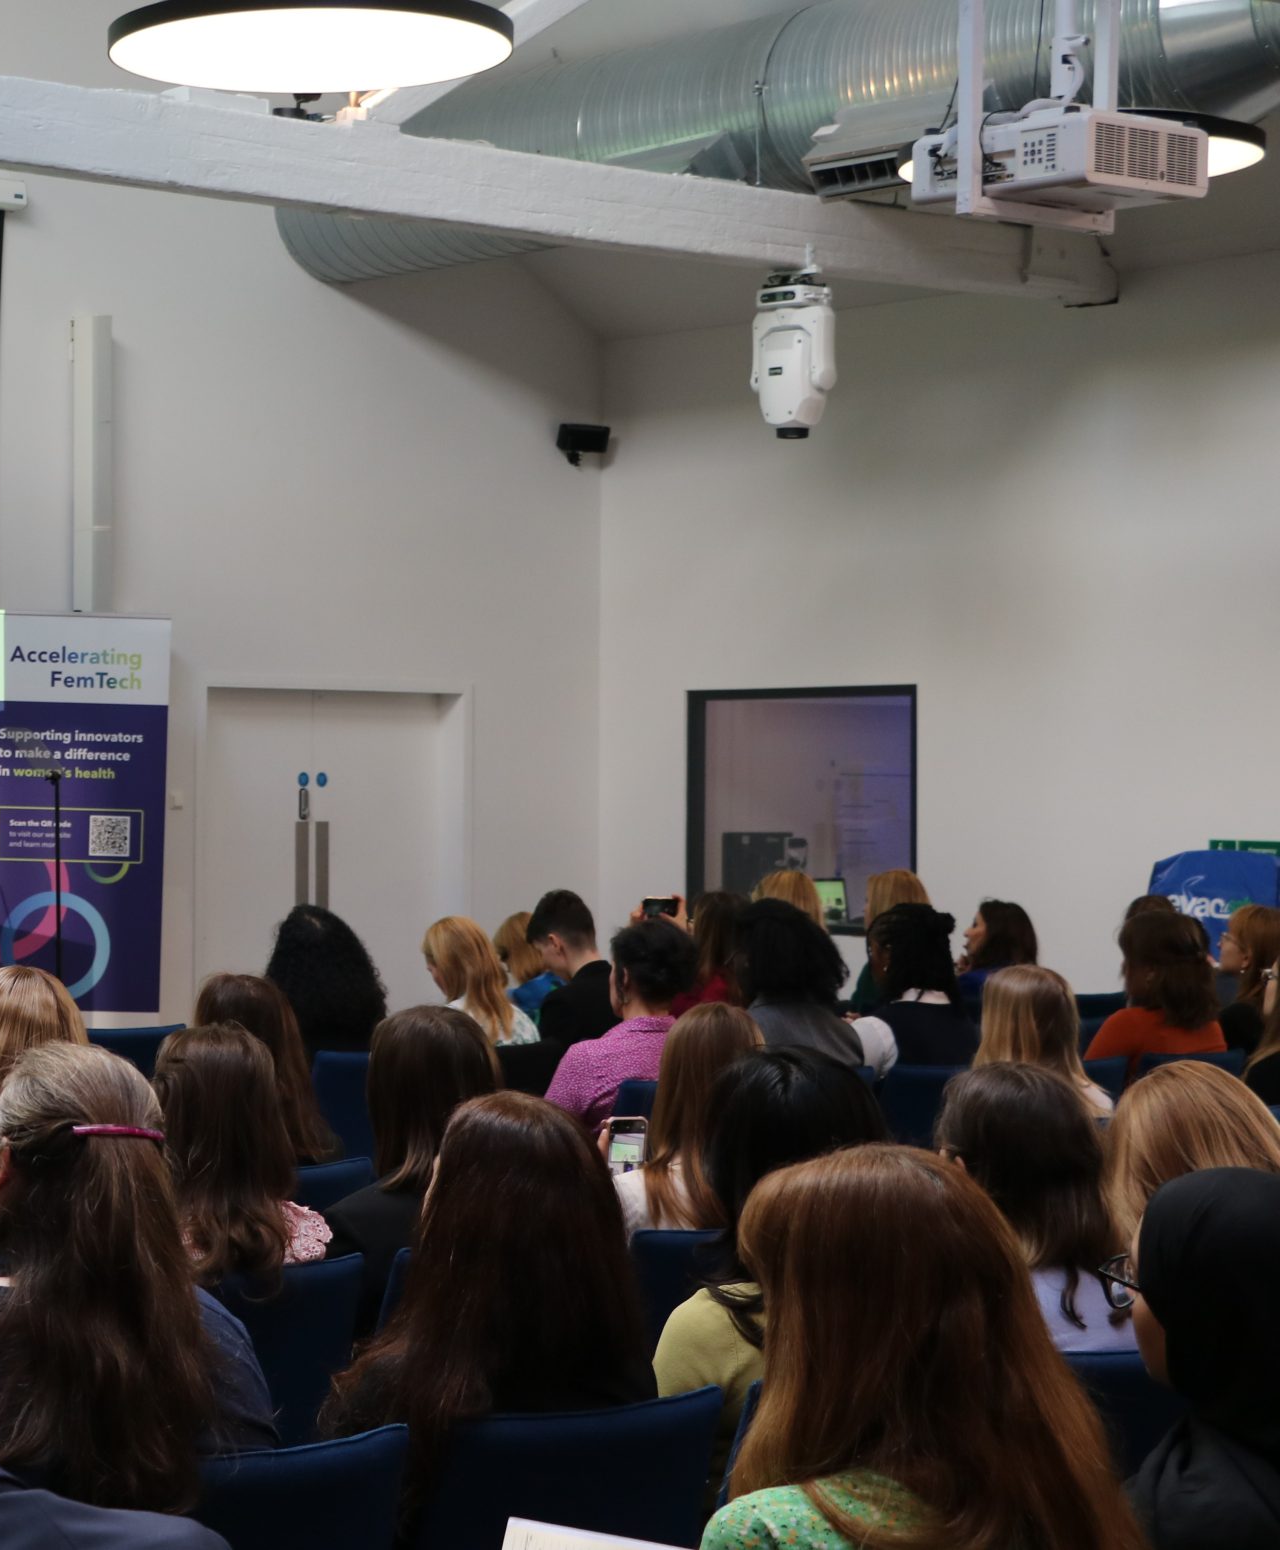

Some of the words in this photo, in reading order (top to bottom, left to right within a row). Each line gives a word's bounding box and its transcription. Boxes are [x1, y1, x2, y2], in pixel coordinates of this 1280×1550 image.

[10, 645, 142, 670] Accelerating
[50, 671, 142, 690] FemTech
[74, 730, 143, 743] innovators
[15, 748, 51, 759] make
[53, 751, 61, 759] a
[64, 748, 131, 761] difference
[13, 766, 72, 778] wome's
[74, 767, 115, 779] health
[28, 819, 39, 827] the
[45, 831, 71, 839] wesite
